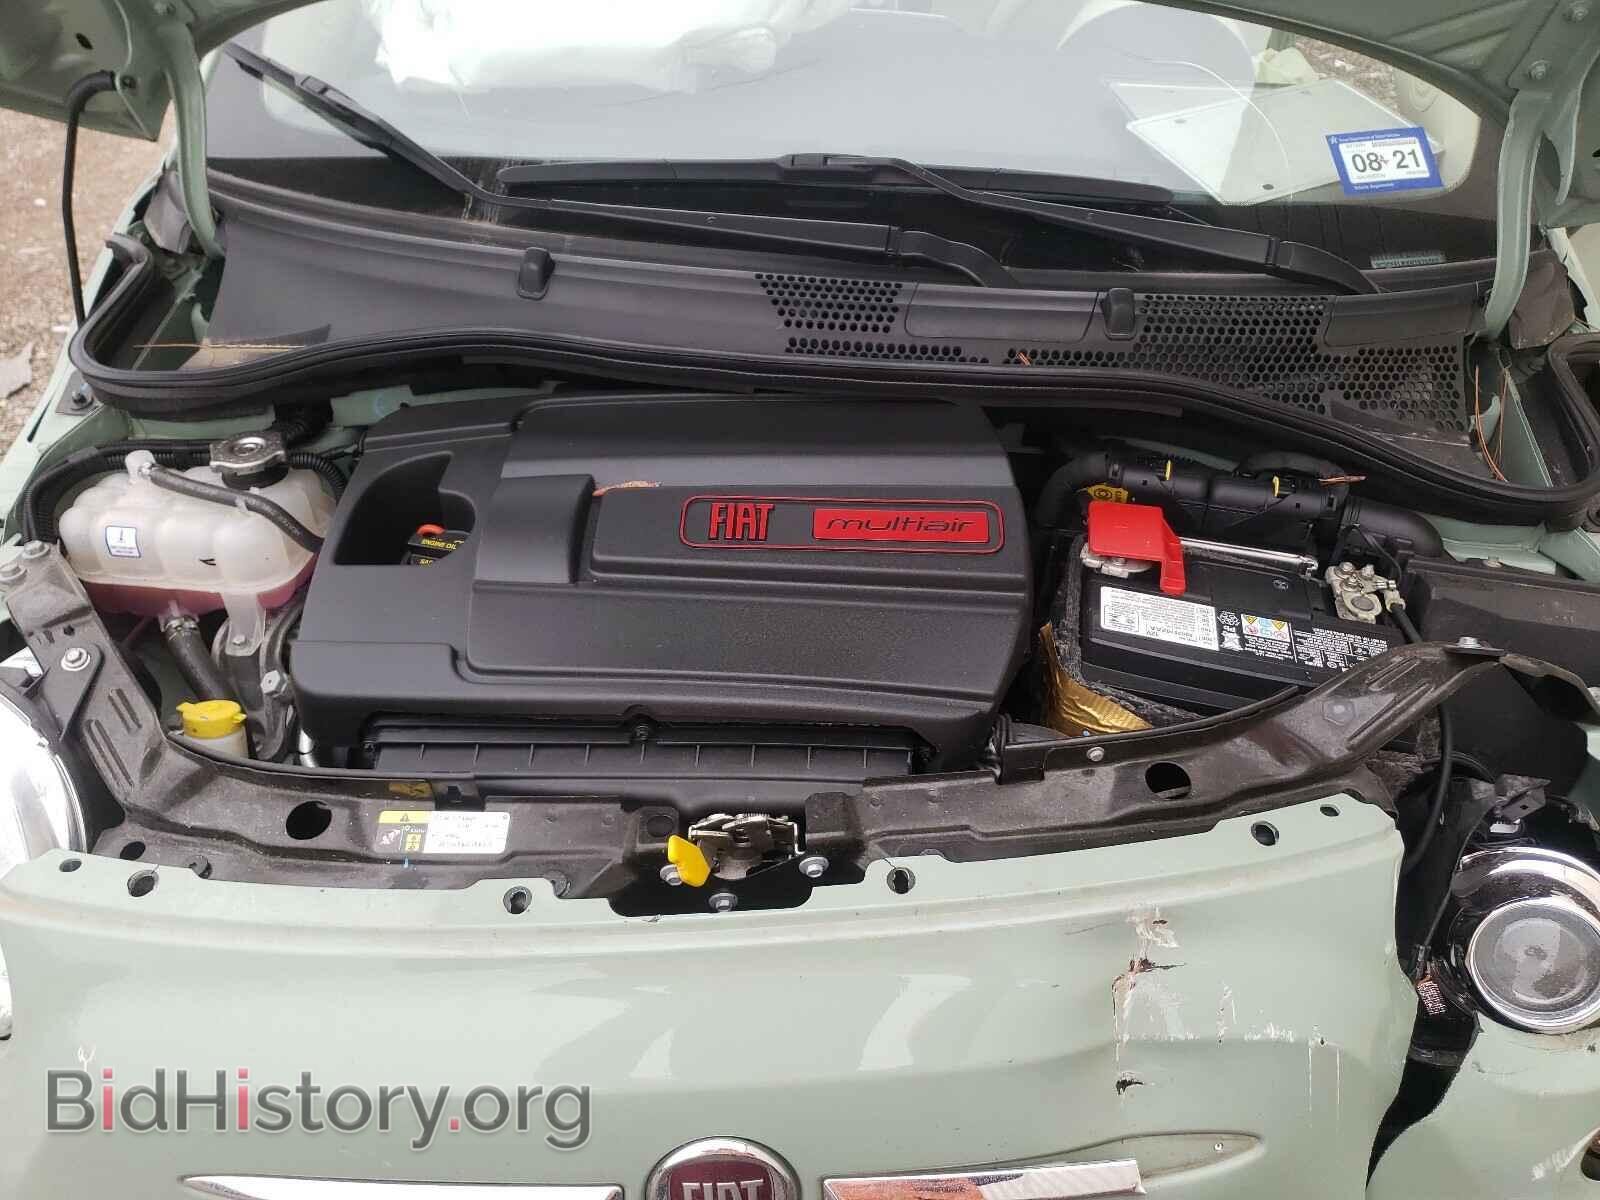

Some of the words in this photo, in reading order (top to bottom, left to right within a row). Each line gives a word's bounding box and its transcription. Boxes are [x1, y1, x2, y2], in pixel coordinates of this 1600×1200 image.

[1351, 151, 1382, 173] 08
[1392, 148, 1421, 169] 21
[708, 502, 775, 542] FIAT
[825, 513, 977, 534] multiair
